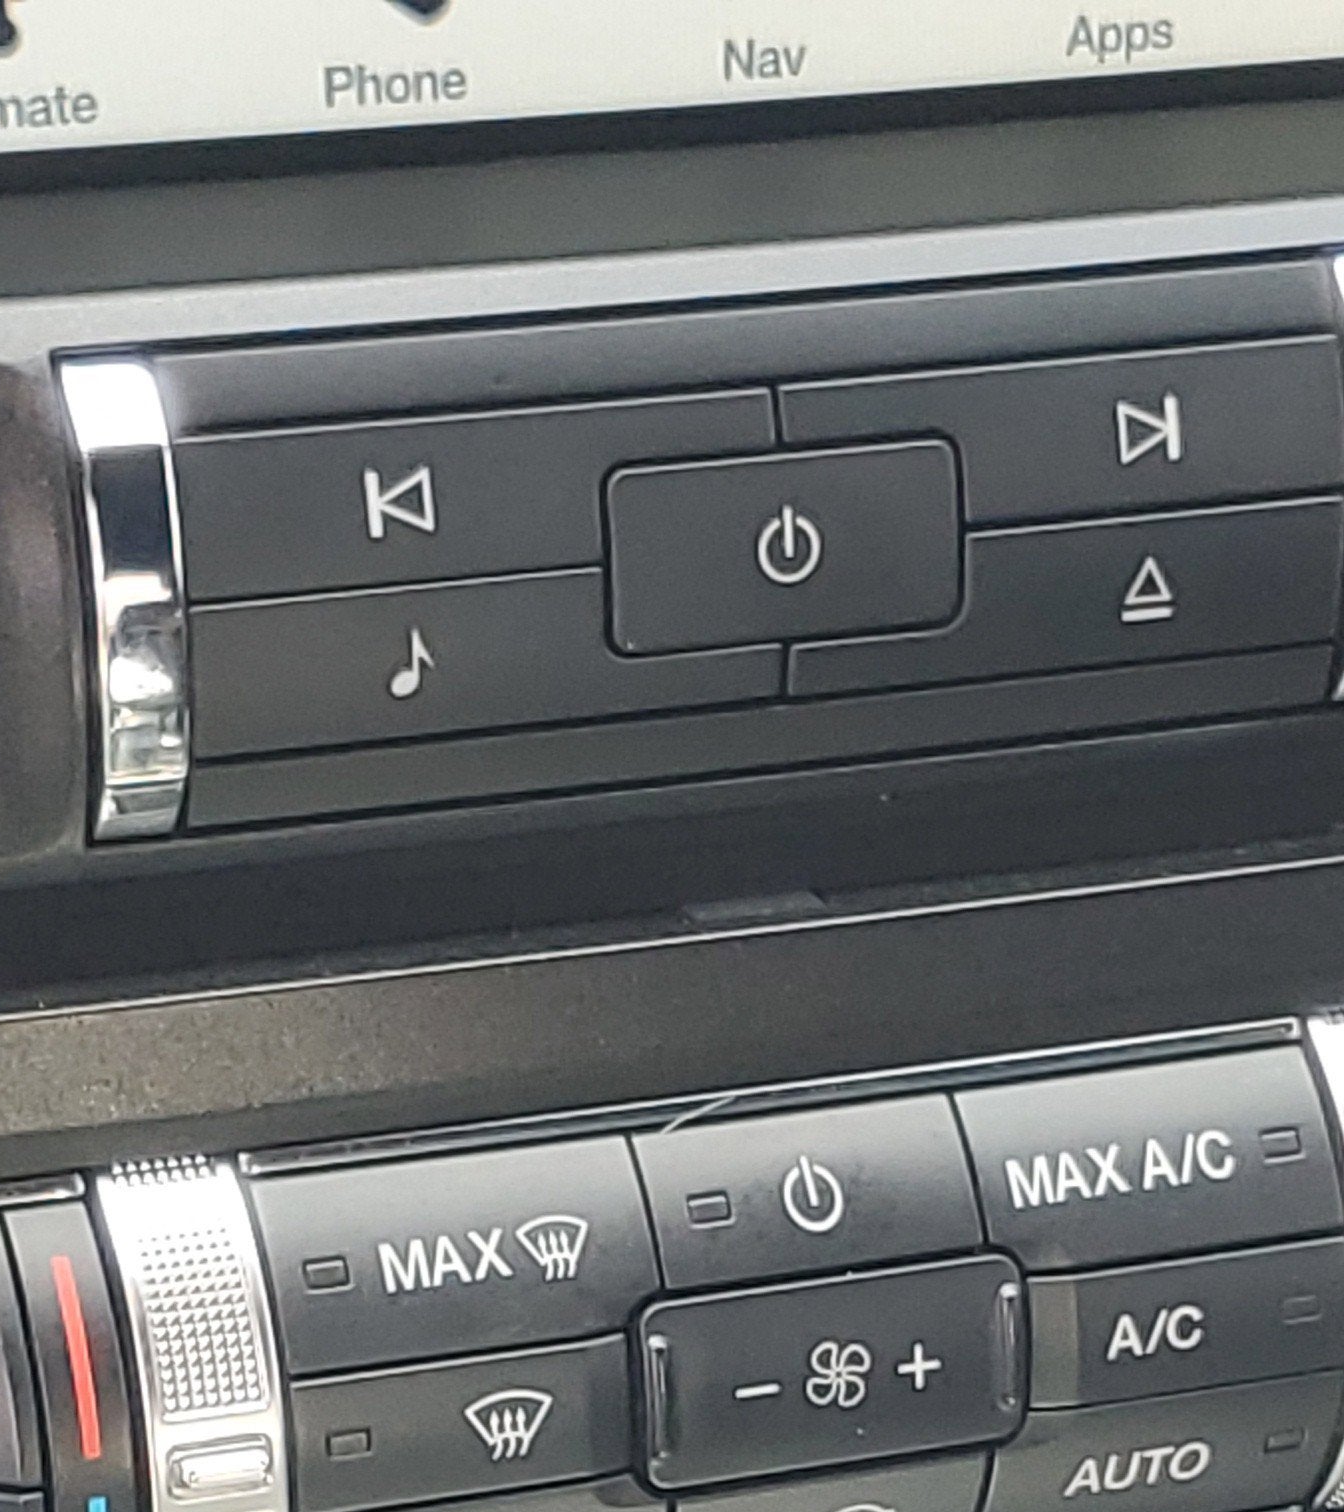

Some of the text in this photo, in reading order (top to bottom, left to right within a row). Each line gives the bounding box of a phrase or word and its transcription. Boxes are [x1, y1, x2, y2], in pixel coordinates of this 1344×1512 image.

[722, 38, 807, 80] Nav
[1066, 16, 1174, 64] Apps
[323, 64, 468, 107] Phone
[1006, 1128, 1236, 1209] MAX A/C
[377, 1227, 514, 1294] MAX
[1106, 1306, 1205, 1359] A/C
[1063, 1442, 1212, 1498] AUTO
